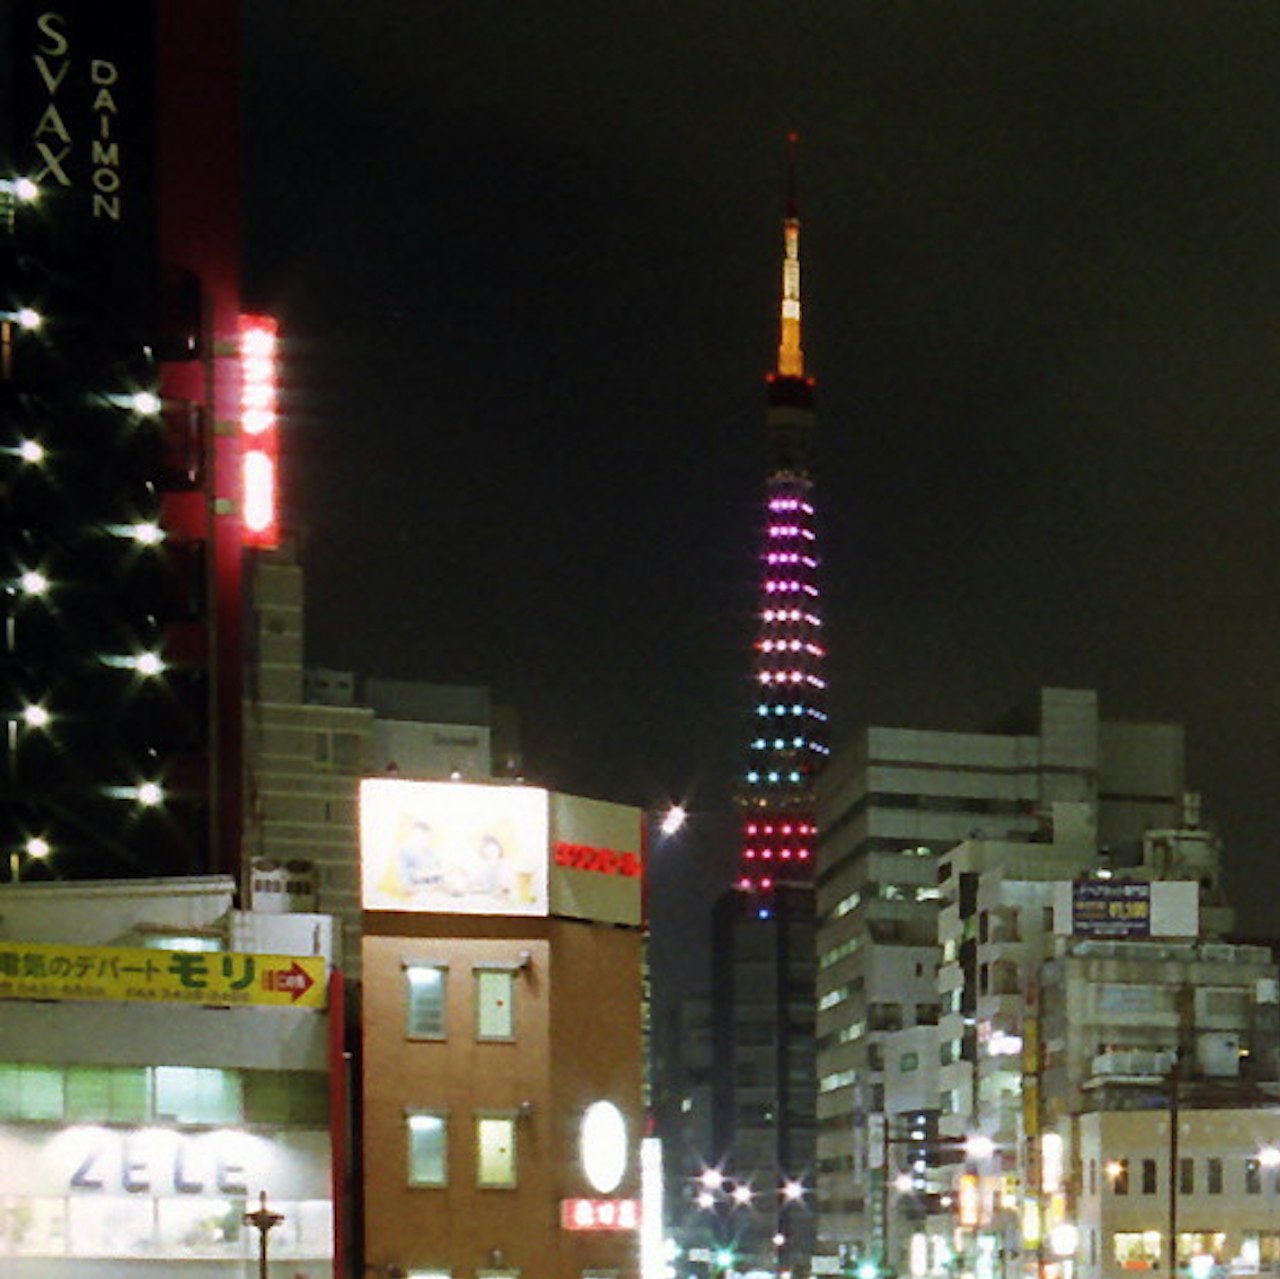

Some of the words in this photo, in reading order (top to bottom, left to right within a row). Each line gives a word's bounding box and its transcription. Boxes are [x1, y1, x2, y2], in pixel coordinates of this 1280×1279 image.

[34, 13, 72, 187] SVAX
[91, 59, 121, 220] DAIMON
[168, 953, 255, 989] モリ
[69, 1138, 248, 1195] ZELE
